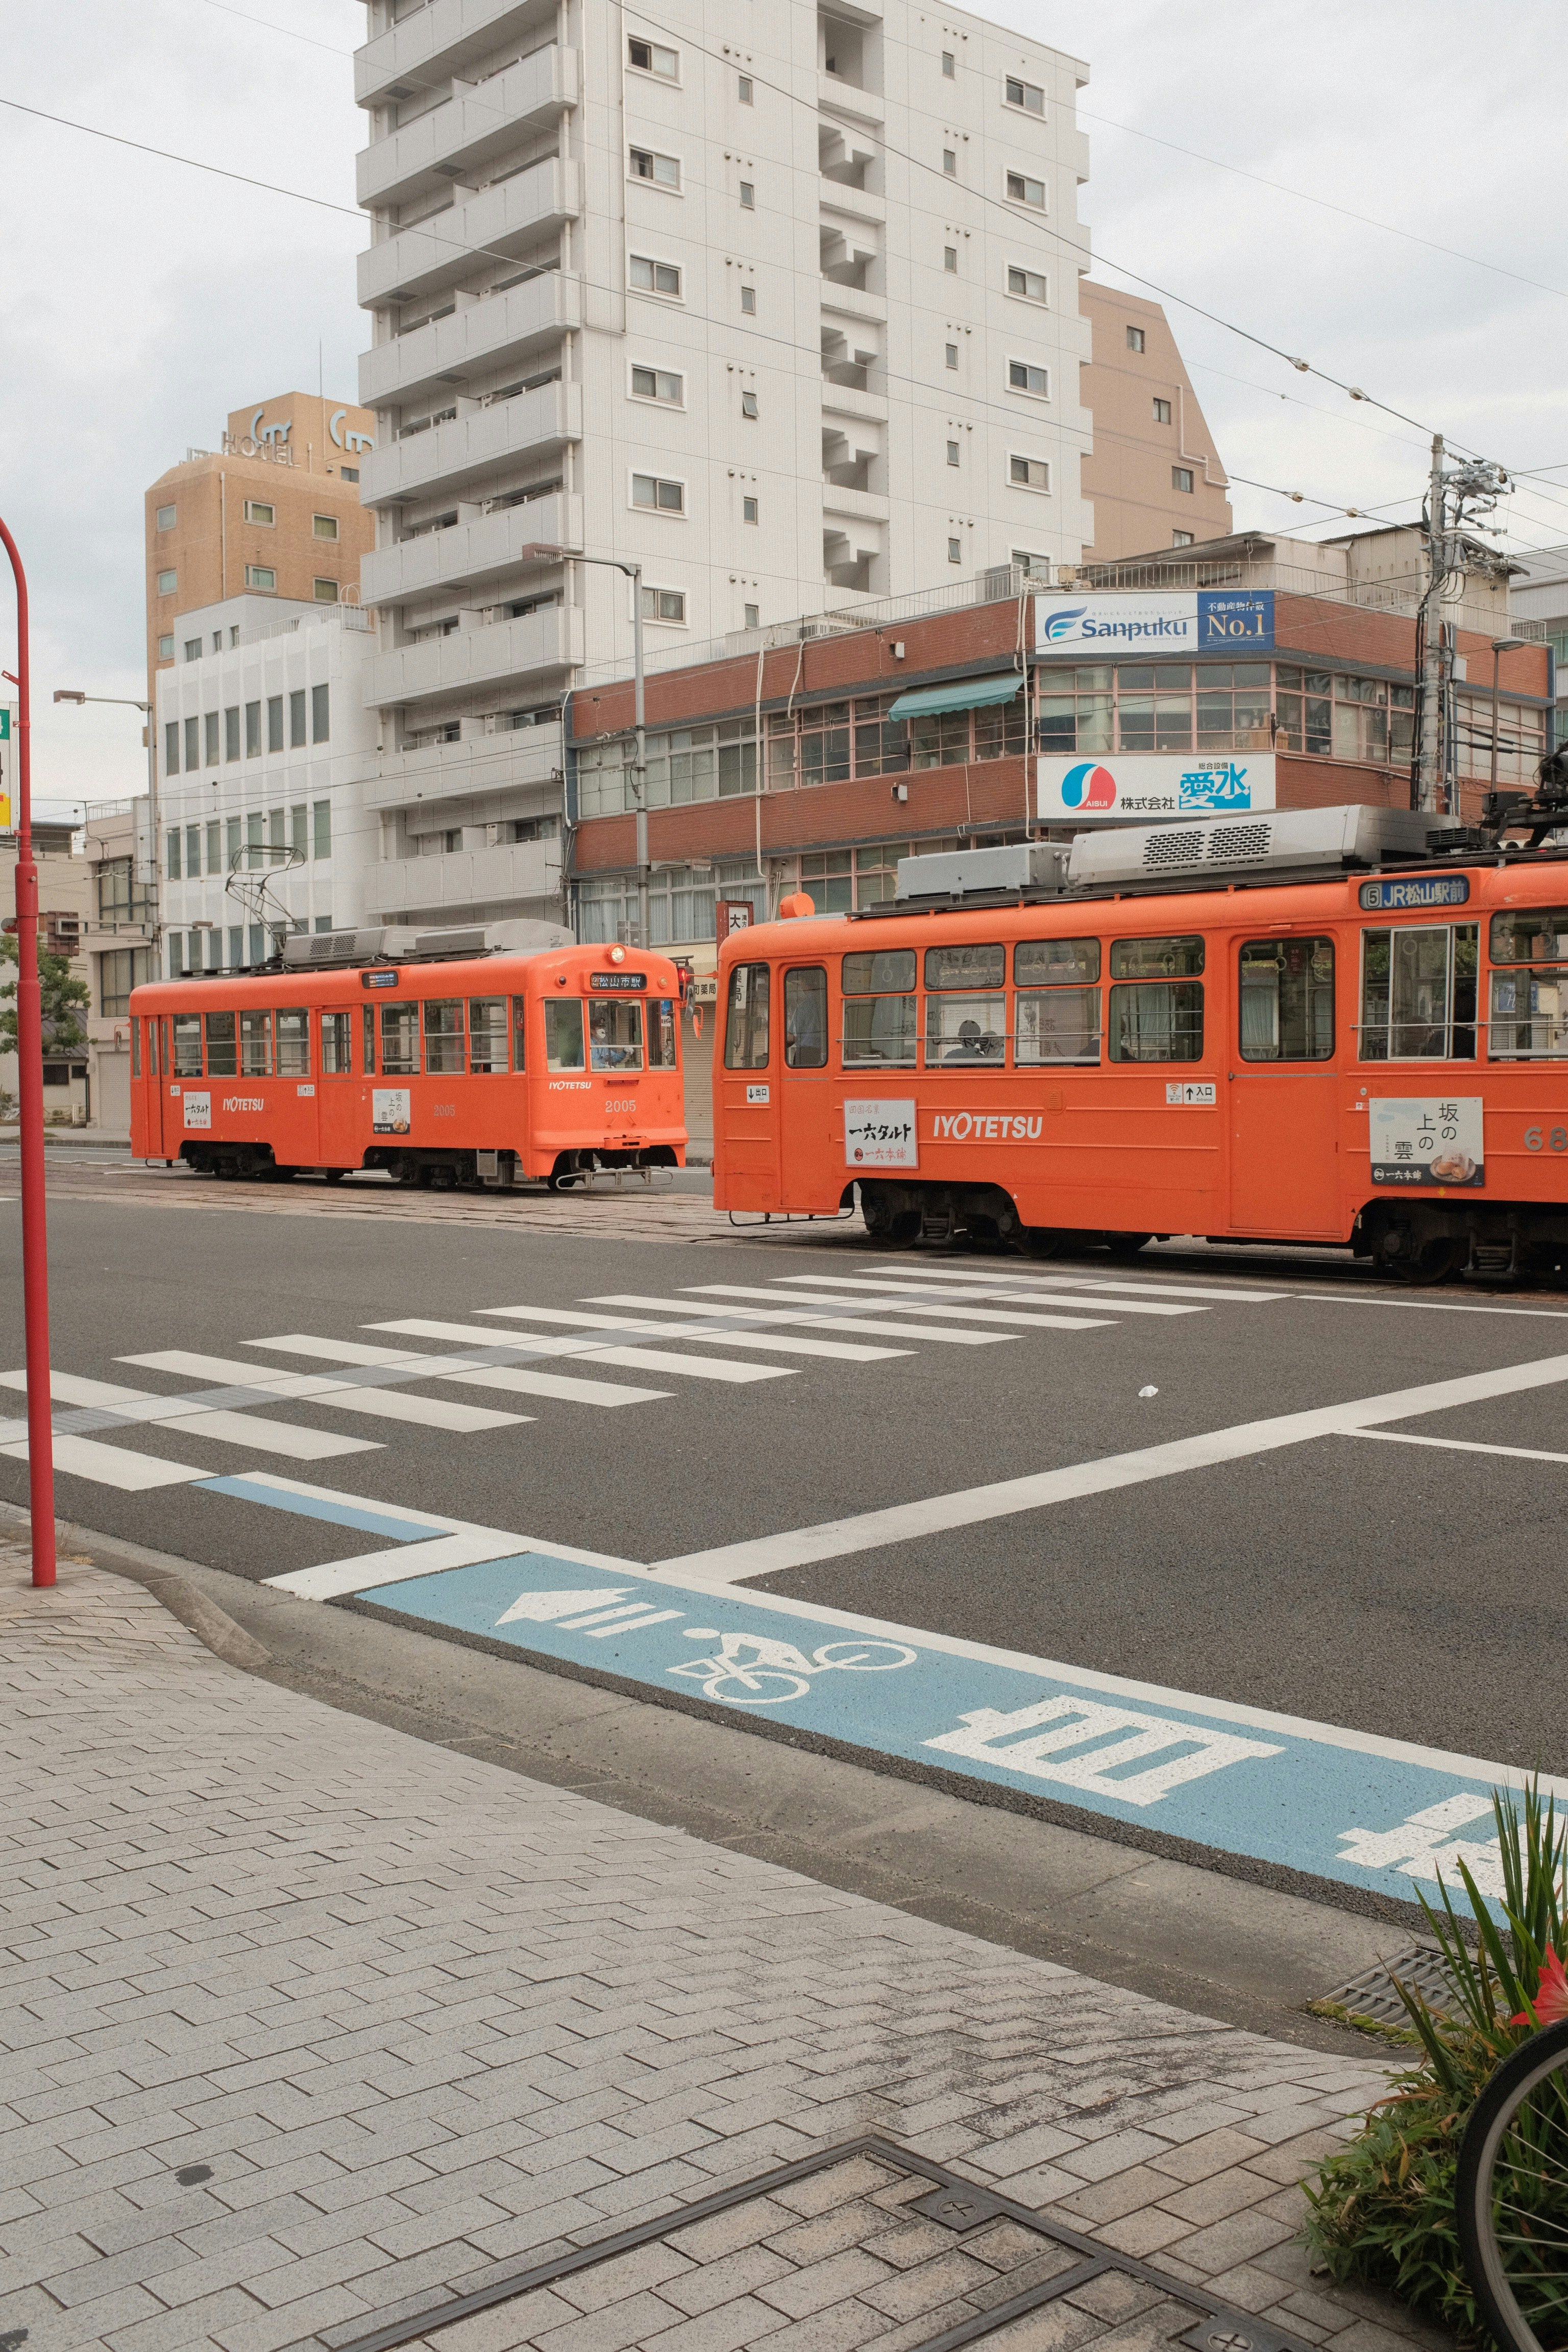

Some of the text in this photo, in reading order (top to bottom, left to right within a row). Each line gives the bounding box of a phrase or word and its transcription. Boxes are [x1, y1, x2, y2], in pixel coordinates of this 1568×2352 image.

[222, 431, 301, 468] HOTEL
[1208, 601, 1264, 611] 不動産物件数
[1081, 617, 1187, 641] Sanpuku
[1207, 614, 1264, 636] No.1
[1120, 797, 1174, 810] 株式会社
[1384, 880, 1464, 907] JR松山駅前
[730, 914, 741, 928] 大
[599, 975, 641, 988] 松山市駅
[549, 1081, 592, 1090] IYOTETSU
[1196, 1087, 1212, 1095] 入口
[223, 1096, 264, 1112] IYOTETSU
[388, 1097, 395, 1116] 上の
[396, 1092, 402, 1111] 坂の
[434, 1105, 455, 1117] 2005
[605, 1099, 636, 1113] 2005
[849, 1104, 880, 1114] 四国名菓
[934, 1112, 1043, 1140] IYOTETSU
[1438, 1102, 1459, 1140] 坂の
[849, 1123, 912, 1142] 一六タルト
[1417, 1114, 1436, 1150] 上の
[1394, 1141, 1413, 1160] 雲
